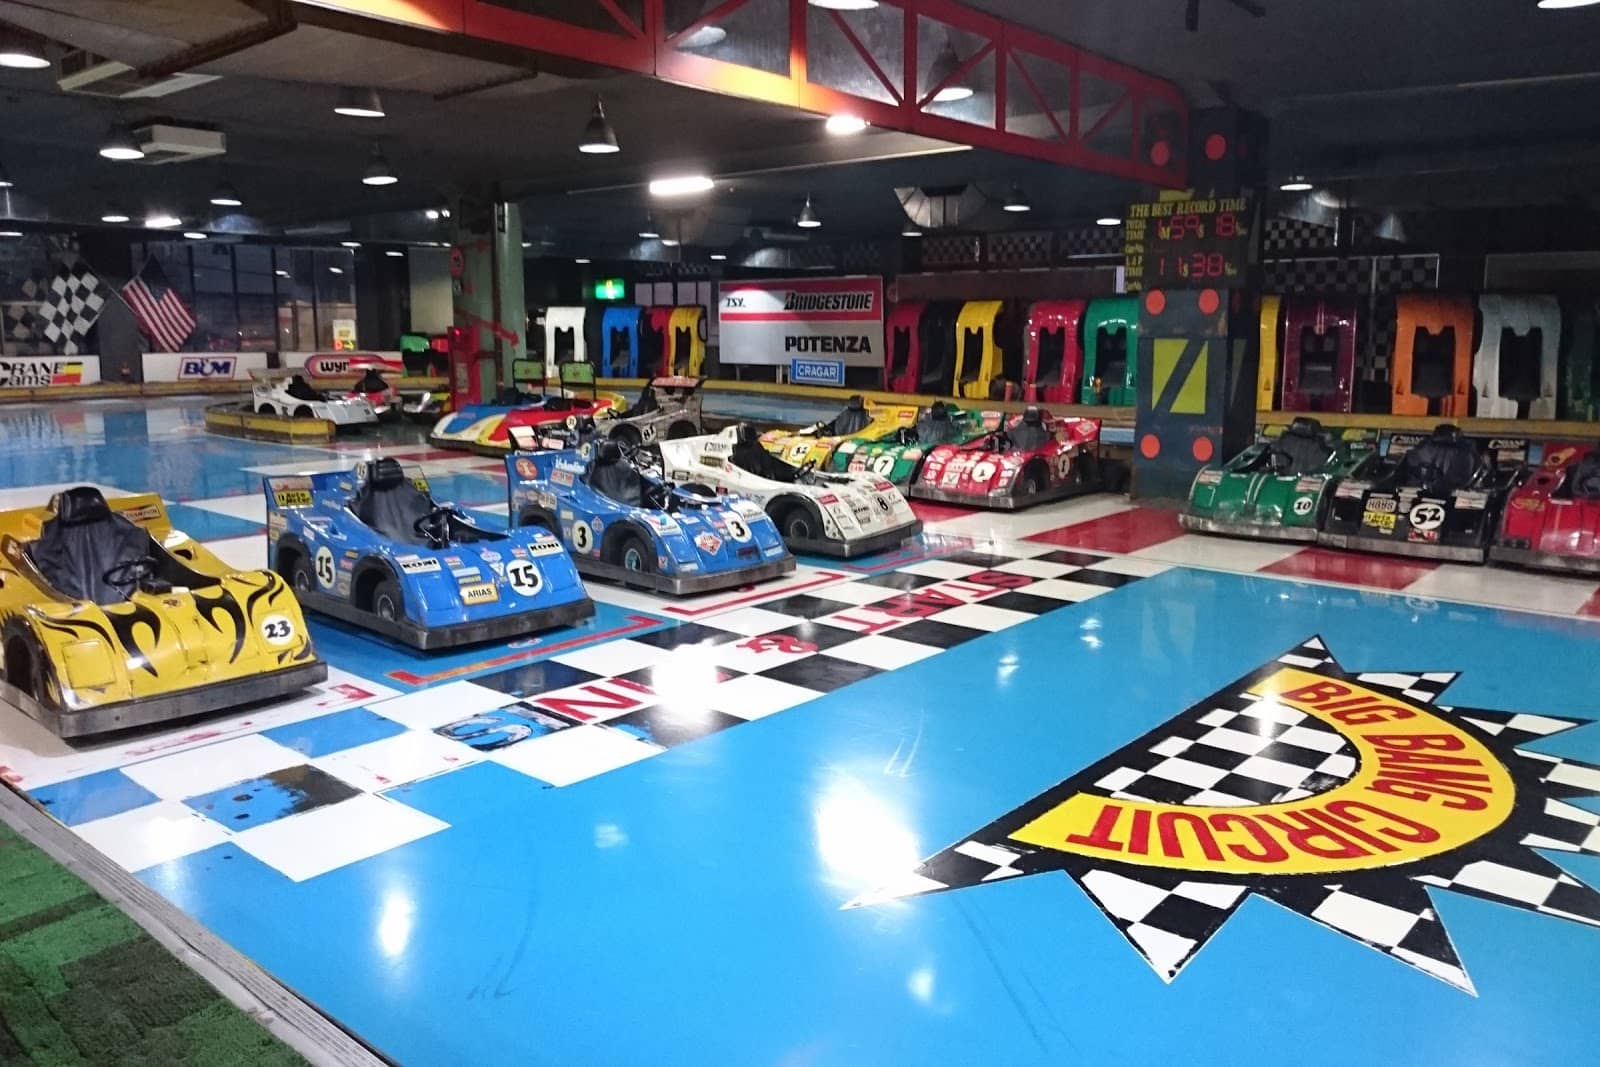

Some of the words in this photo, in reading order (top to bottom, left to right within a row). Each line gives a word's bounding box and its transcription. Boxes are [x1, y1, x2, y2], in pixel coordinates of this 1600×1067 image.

[1130, 204, 1150, 217] THE
[1151, 202, 1175, 216] BEST
[1176, 200, 1216, 214] RECORD
[1219, 198, 1247, 212] TIME
[1126, 219, 1147, 229] TOTAL
[1126, 229, 1145, 240] TIME
[1126, 266, 1144, 277] TIME
[784, 291, 873, 311] BRIDGESTONE
[784, 335, 873, 353] POTENZA
[183, 359, 231, 376] B&M
[797, 364, 838, 378] CRAGAR
[881, 459, 890, 474] 7
[877, 497, 888, 511] 8
[1296, 501, 1311, 511] 10
[1414, 508, 1441, 525] 52
[577, 526, 587, 548] 3
[731, 521, 745, 537] 3
[530, 542, 560, 551] KONI
[317, 556, 333, 583] 15
[510, 564, 539, 588] 15
[467, 588, 493, 598] ARIAS
[831, 570, 1033, 634] START
[264, 620, 291, 639] 23
[736, 634, 819, 655] &
[1291, 679, 1418, 727] BIG
[1359, 733, 1495, 812] BANG
[1066, 799, 1441, 864] CIRCUIT
